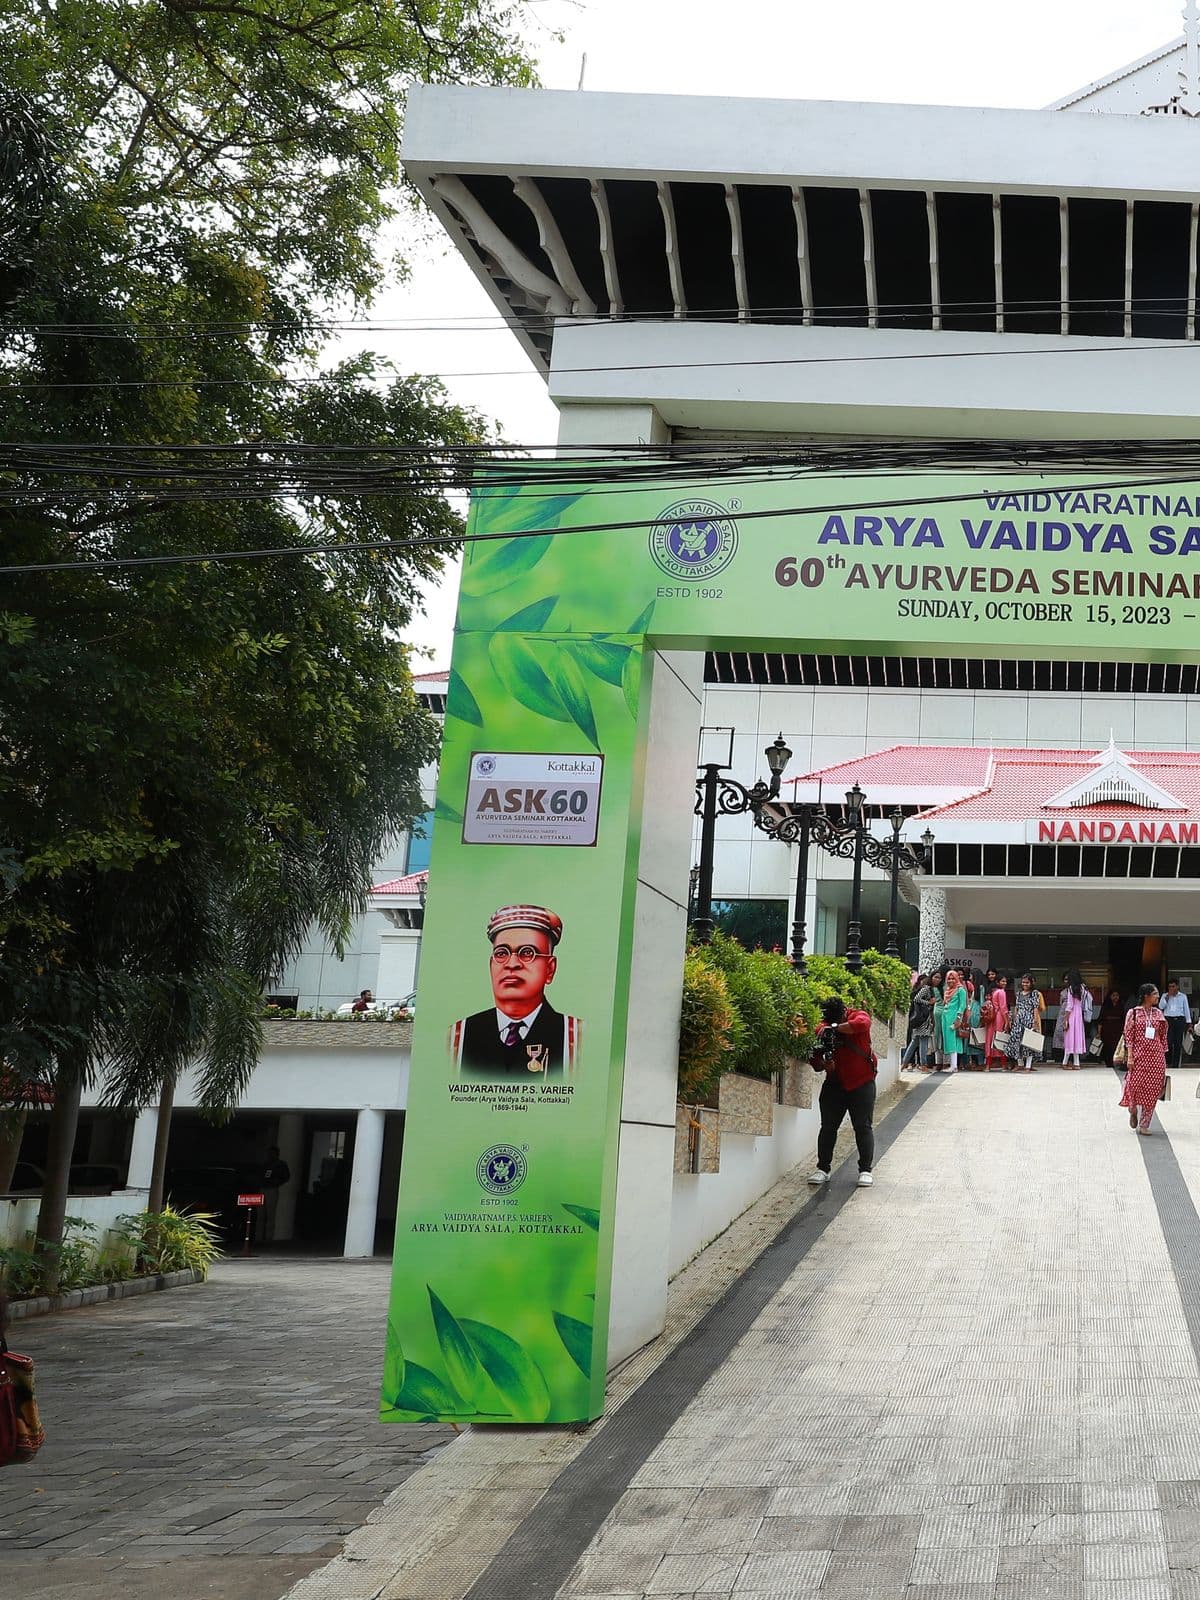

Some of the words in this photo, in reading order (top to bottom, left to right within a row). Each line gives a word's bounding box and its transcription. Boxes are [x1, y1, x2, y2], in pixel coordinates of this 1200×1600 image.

[656, 529, 665, 551] THE
[721, 524, 732, 552] SALA
[817, 515, 945, 547] ARYA
[960, 519, 1133, 554] VAIDYA
[664, 558, 718, 576] KOTTAKAL
[774, 554, 846, 587] 60th
[844, 563, 1041, 594] AYURVEDA
[656, 587, 691, 598] ESTD
[696, 588, 723, 599] 1902
[548, 760, 596, 772] Kottakkal
[514, 814, 545, 822] SEMINAR
[546, 815, 587, 823] KOTTAKKAL
[1038, 821, 1199, 844] NANDANAM
[448, 1084, 520, 1094] VAIDYARATNAM
[521, 1085, 538, 1094] P.S.
[540, 1086, 575, 1095] VARIER
[479, 1095, 497, 1104] (Arya
[498, 1095, 519, 1104] Vaidya
[520, 1096, 537, 1104] Sala,
[537, 1096, 571, 1105] Kottakkal)
[444, 1213, 505, 1222] VAIDYARATNAM
[411, 1223, 439, 1233] ARYA
[442, 1223, 481, 1234] VAIDYA
[484, 1224, 515, 1235] SALA,
[519, 1224, 584, 1235] KOTTAKKAL
